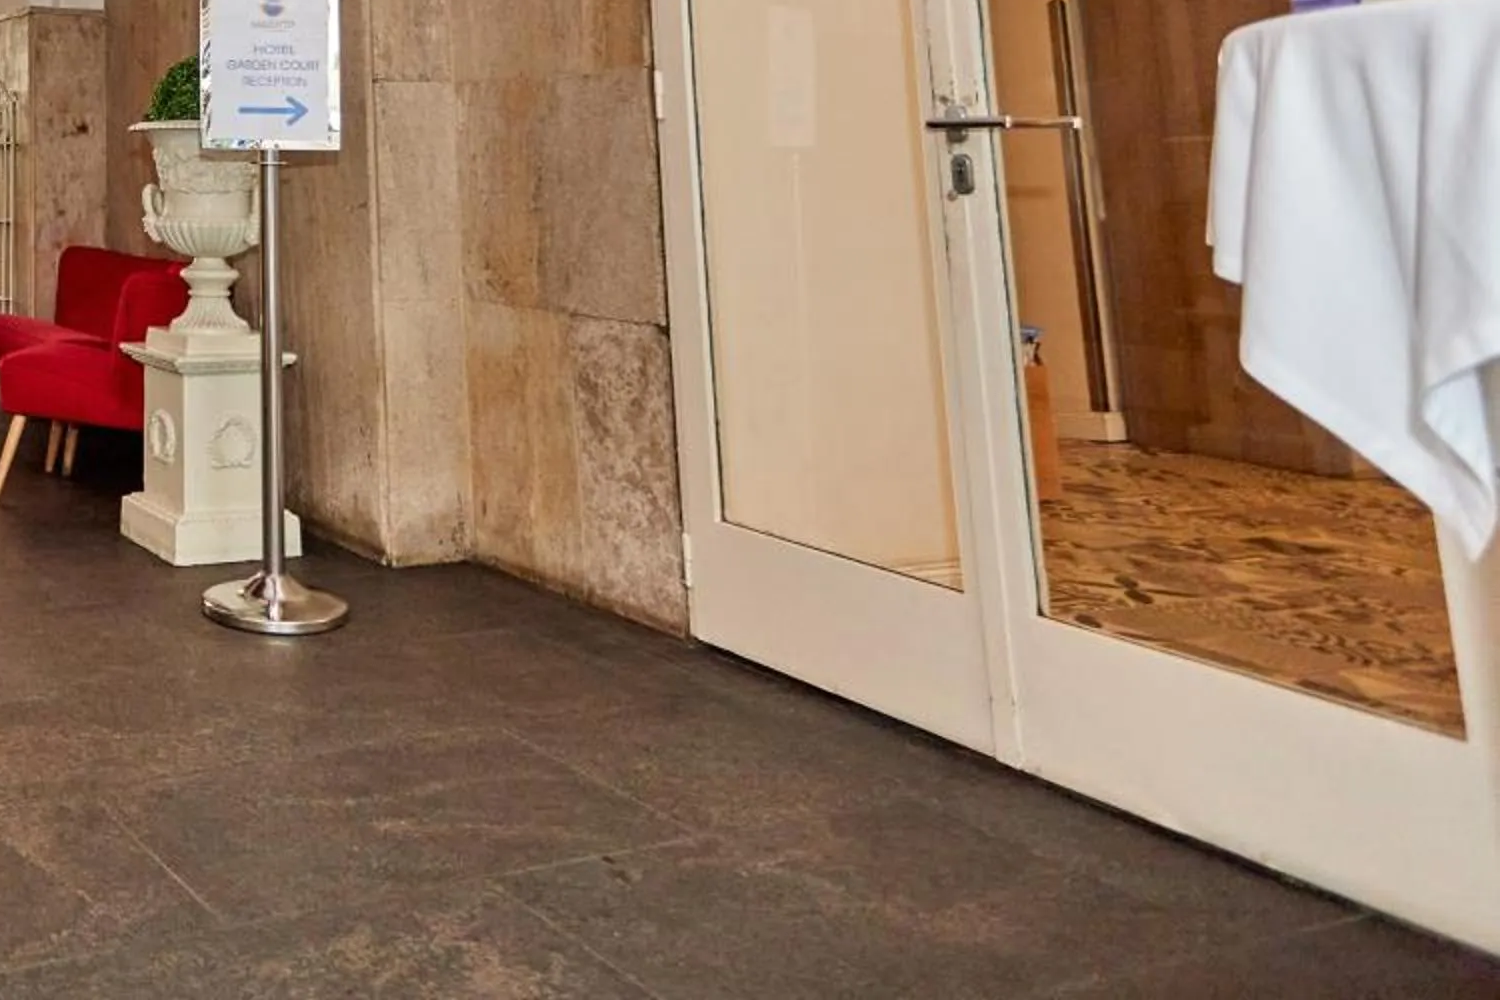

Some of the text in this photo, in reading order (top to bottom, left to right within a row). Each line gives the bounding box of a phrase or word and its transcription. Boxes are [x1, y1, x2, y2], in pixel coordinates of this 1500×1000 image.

[253, 44, 294, 56] HOTEL
[226, 59, 320, 72] GARDEN COURT
[241, 75, 308, 88] RECEPTION
